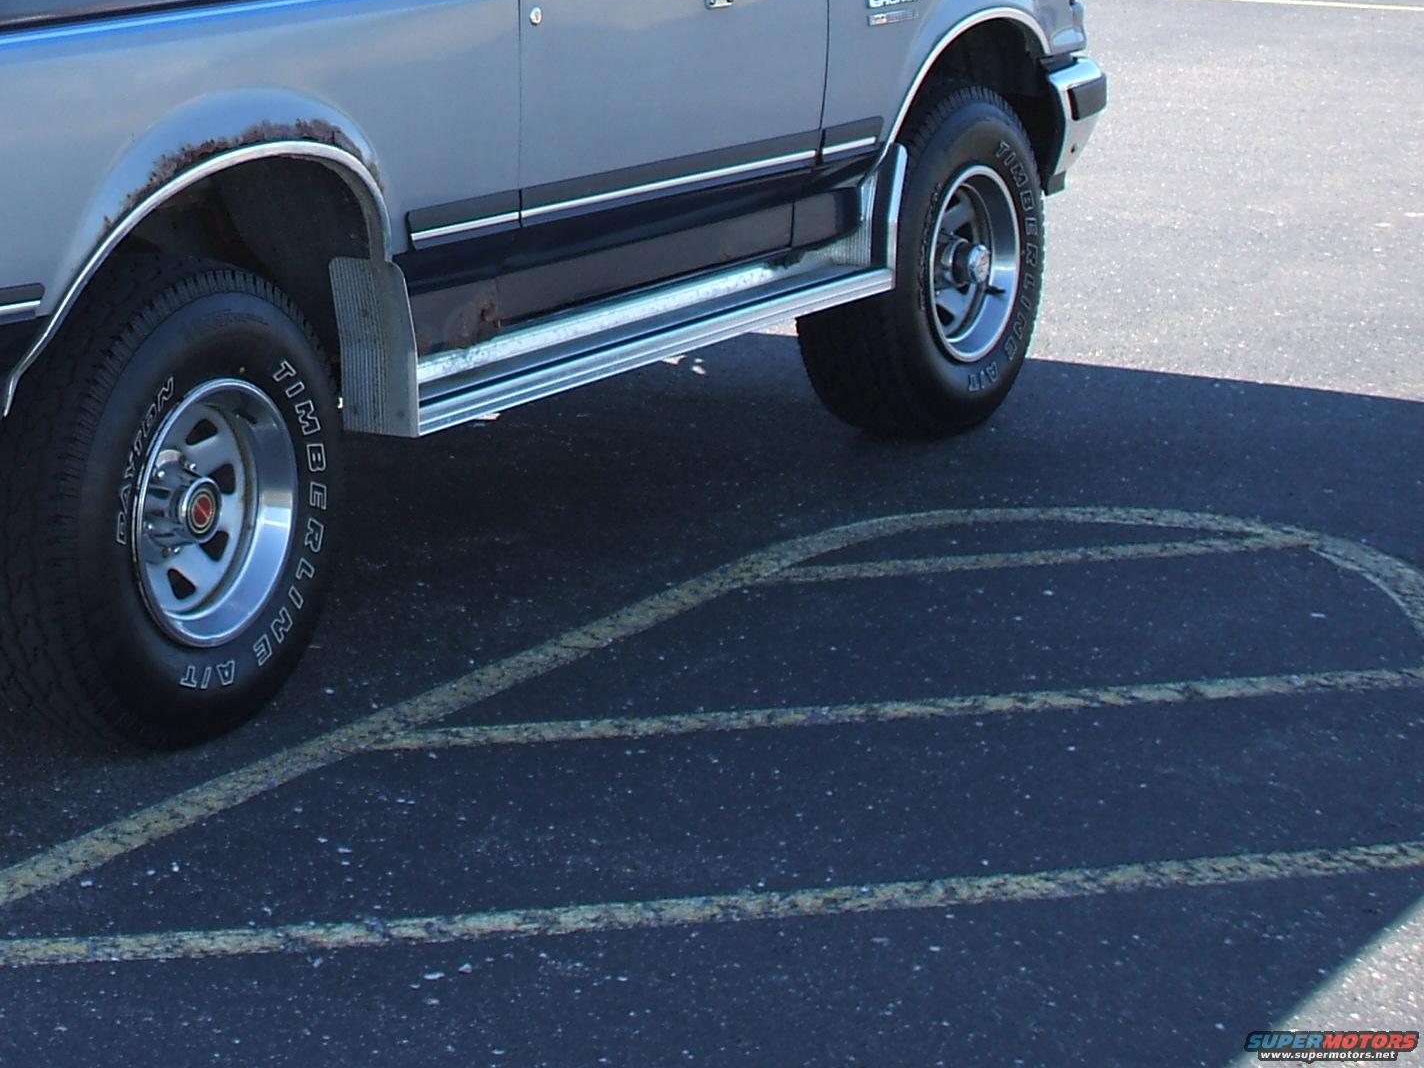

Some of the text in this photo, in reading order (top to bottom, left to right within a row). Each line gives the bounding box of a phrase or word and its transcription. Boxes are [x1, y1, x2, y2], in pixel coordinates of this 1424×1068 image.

[116, 360, 327, 690] DAYTON TIMBERLINE A/T
